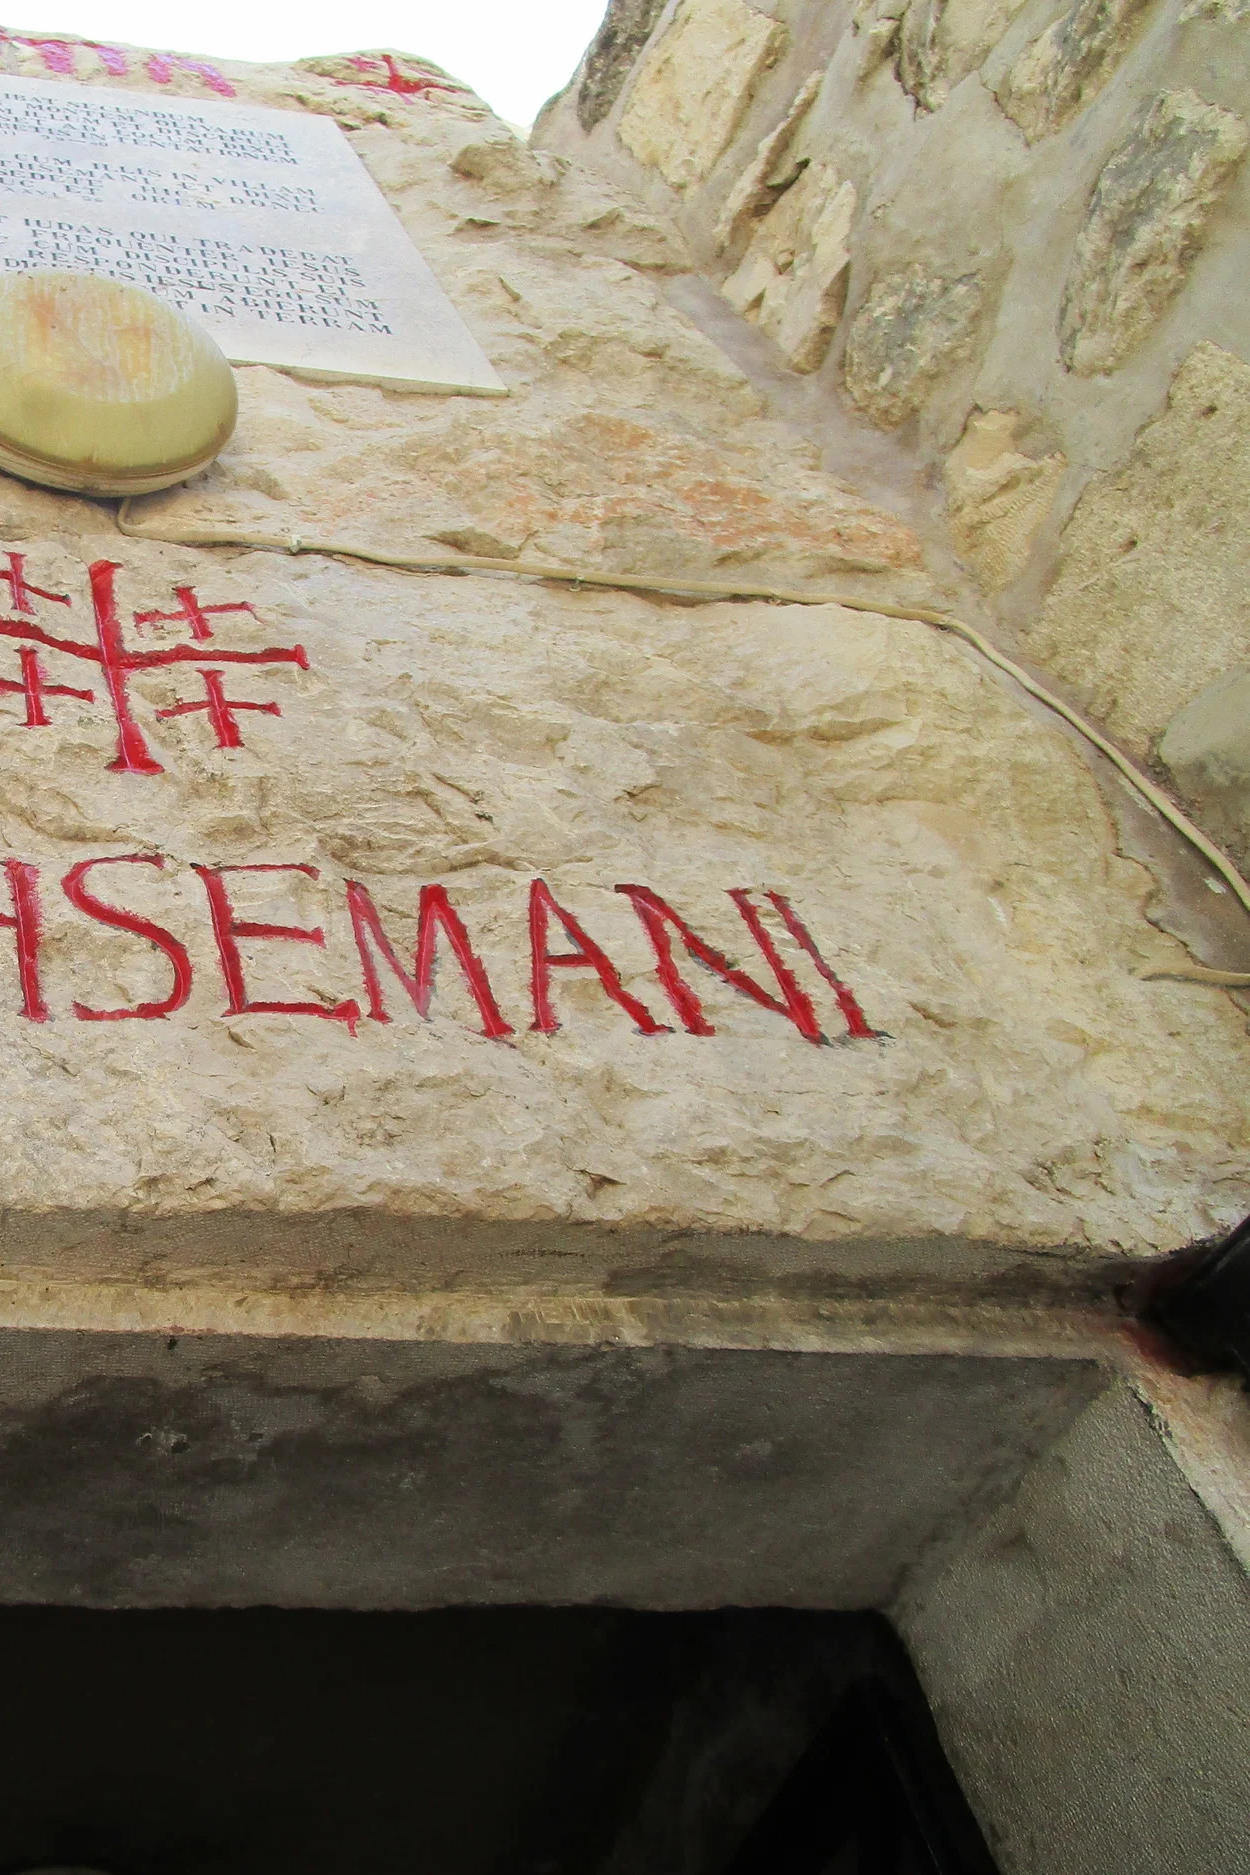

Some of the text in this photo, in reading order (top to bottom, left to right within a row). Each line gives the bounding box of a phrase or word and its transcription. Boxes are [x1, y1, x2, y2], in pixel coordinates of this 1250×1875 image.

[5, 93, 56, 104] IBAT
[67, 101, 203, 123] SECUNDUM
[26, 103, 135, 121] MONTEM
[155, 120, 284, 140] OLIVARUM
[24, 110, 99, 124] ILLUM
[111, 121, 142, 130] ET
[156, 127, 289, 148] DISCIPULI
[62, 123, 95, 131] AD
[115, 129, 202, 145] LOCUM
[222, 142, 292, 155] DIXIT
[80, 132, 105, 140] IN
[112, 136, 297, 164] TENTATIONEM
[14, 153, 70, 166] CUM
[92, 162, 161, 176] ILLIS
[172, 172, 197, 181] IN
[211, 177, 314, 195] VILLAM
[64, 185, 99, 195] ET
[131, 193, 215, 209] OREM
[178, 182, 213, 191] ET
[243, 189, 317, 204] DIXIT
[229, 196, 325, 213] DONEC
[23, 218, 113, 235] IUDAS
[129, 231, 177, 243] QUI
[192, 238, 353, 264] TRADEBAT
[31, 229, 237, 261] FREQUENTER
[267, 258, 360, 275] IESUS
[27, 250, 302, 290] RESPONDERUNT
[317, 284, 345, 295] EI
[33, 240, 97, 254] CUM
[124, 250, 287, 276] DISCIPULIS
[299, 272, 365, 286] SUIS
[144, 274, 234, 292] IESUS
[314, 294, 378, 309] SUM
[220, 295, 383, 321] ABIERUNT
[200, 303, 235, 316] IN
[250, 309, 393, 334] TERRAM
